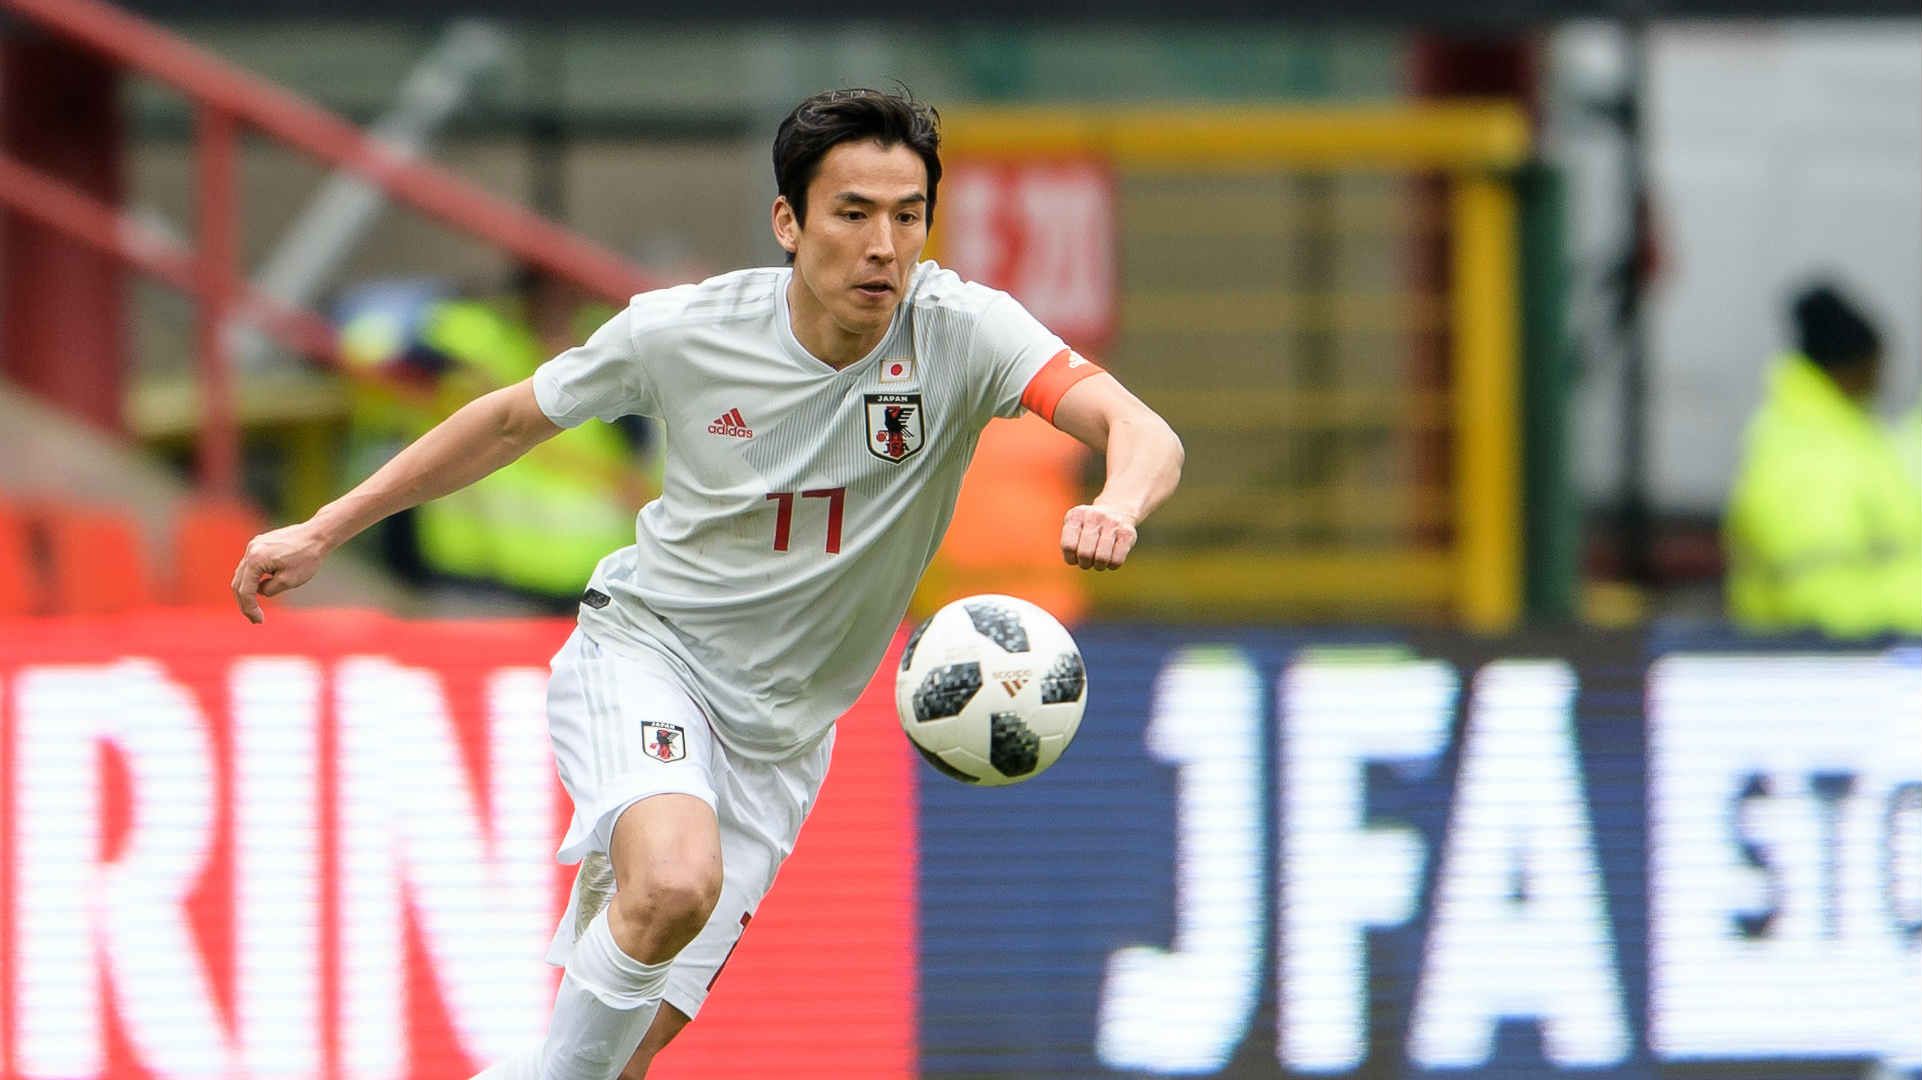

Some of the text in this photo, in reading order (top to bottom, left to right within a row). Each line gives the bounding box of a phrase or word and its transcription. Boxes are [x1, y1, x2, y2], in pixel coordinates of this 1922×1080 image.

[707, 423, 753, 438] adidas
[766, 487, 847, 554] 17
[12, 655, 562, 1080] RIN
[1096, 646, 1633, 1075] JFA
